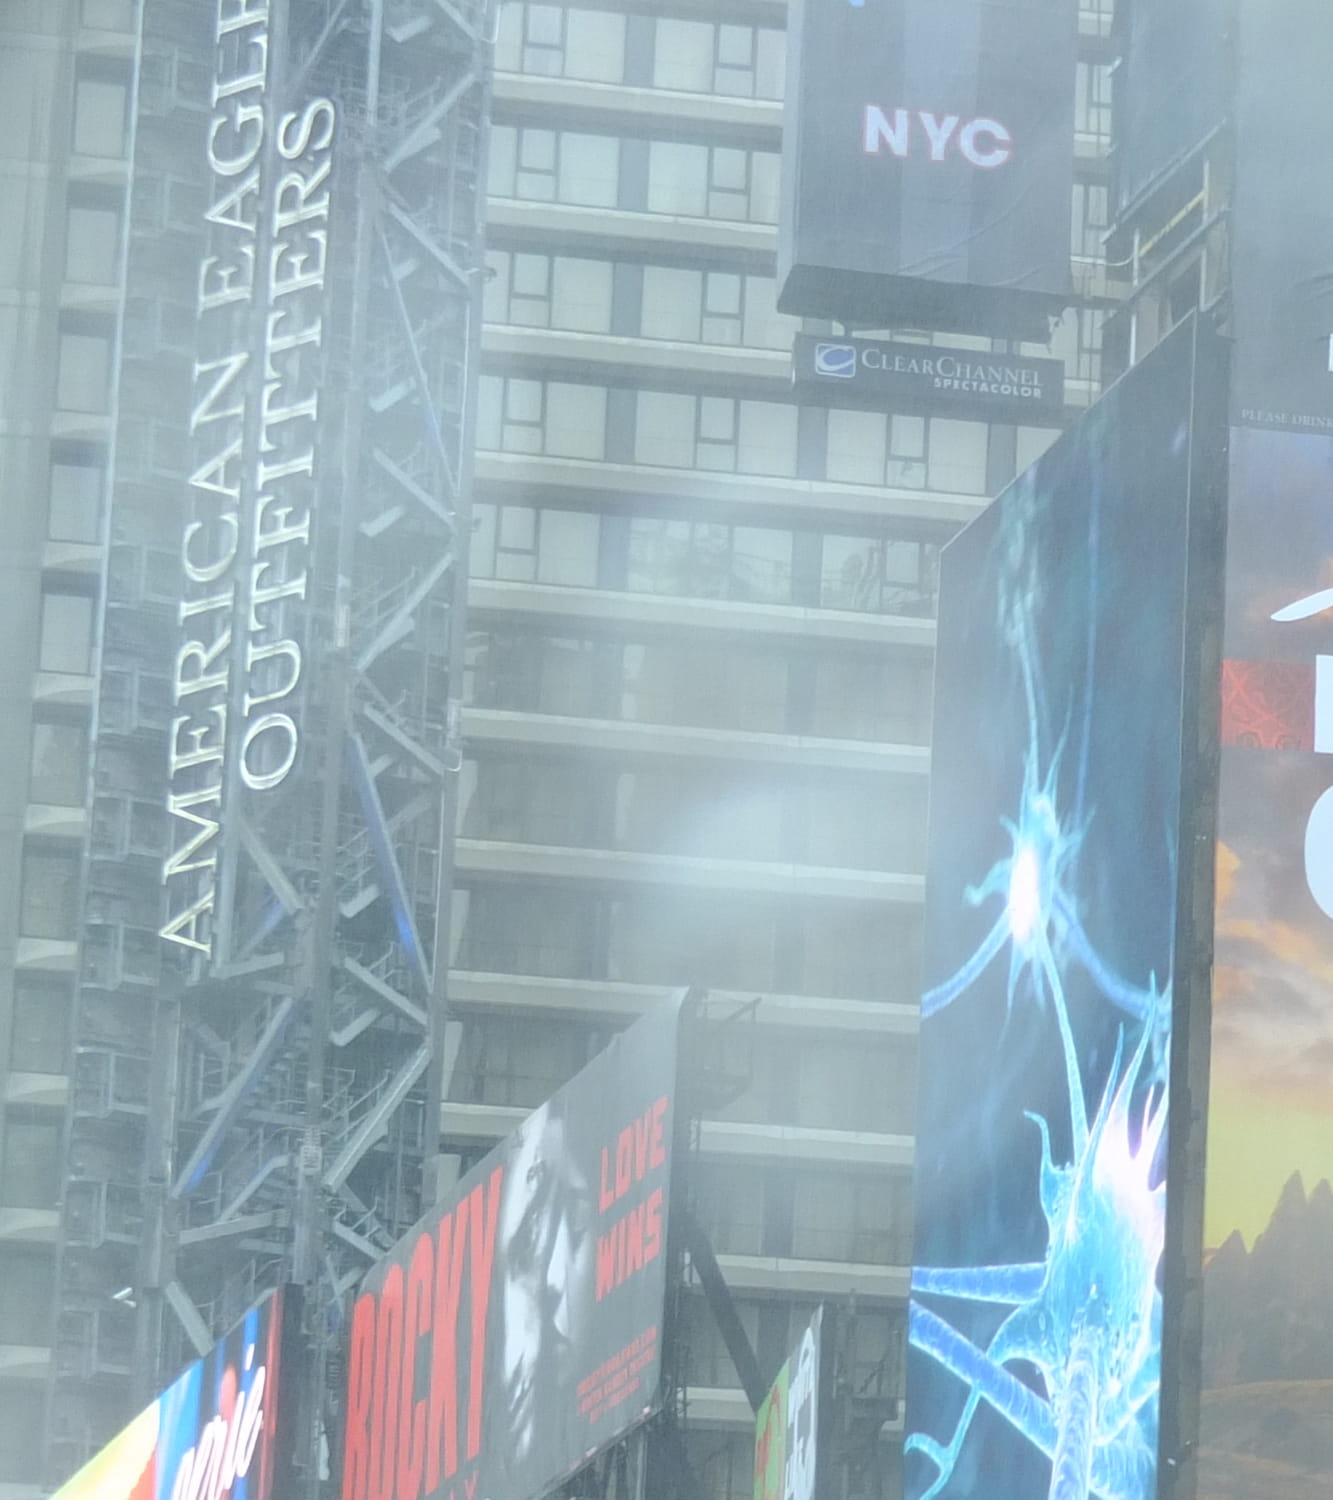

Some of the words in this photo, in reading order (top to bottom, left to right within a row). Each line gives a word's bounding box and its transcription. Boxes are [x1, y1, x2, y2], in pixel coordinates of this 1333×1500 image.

[863, 104, 1011, 168] NYC
[240, 98, 335, 790] OUTFITTERS
[933, 377, 1042, 399] SPECTACOLOR
[1291, 413, 1333, 429] DRINK
[159, 351, 250, 954] AMERICAN
[597, 1095, 669, 1215] LOVE
[593, 1186, 664, 1304] WINS
